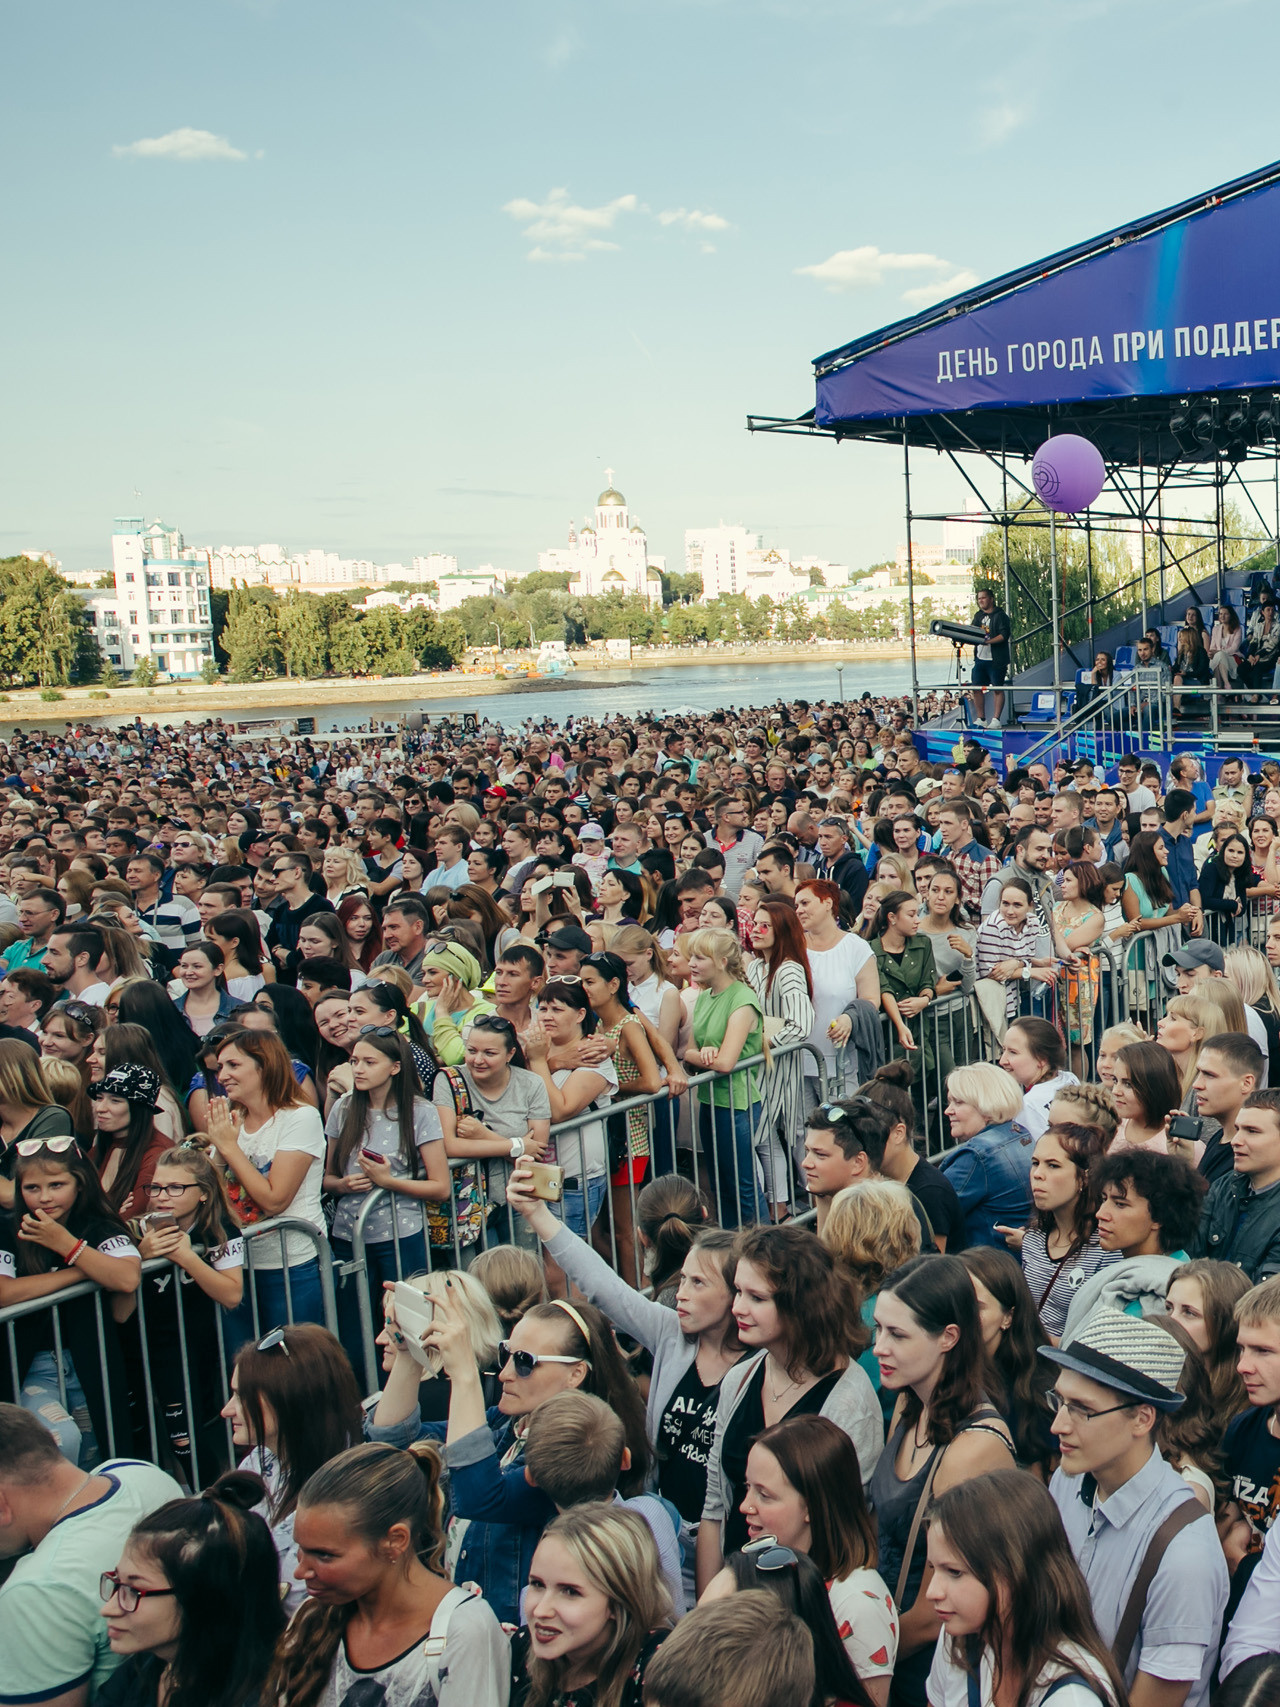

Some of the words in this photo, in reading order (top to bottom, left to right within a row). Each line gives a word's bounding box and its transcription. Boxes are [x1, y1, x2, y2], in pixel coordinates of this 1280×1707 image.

[937, 347, 998, 383] ДЕНЬ
[1007, 335, 1104, 373] ГОРОДА
[1113, 329, 1165, 363] ПРИ
[1233, 1479, 1270, 1507] IZA
